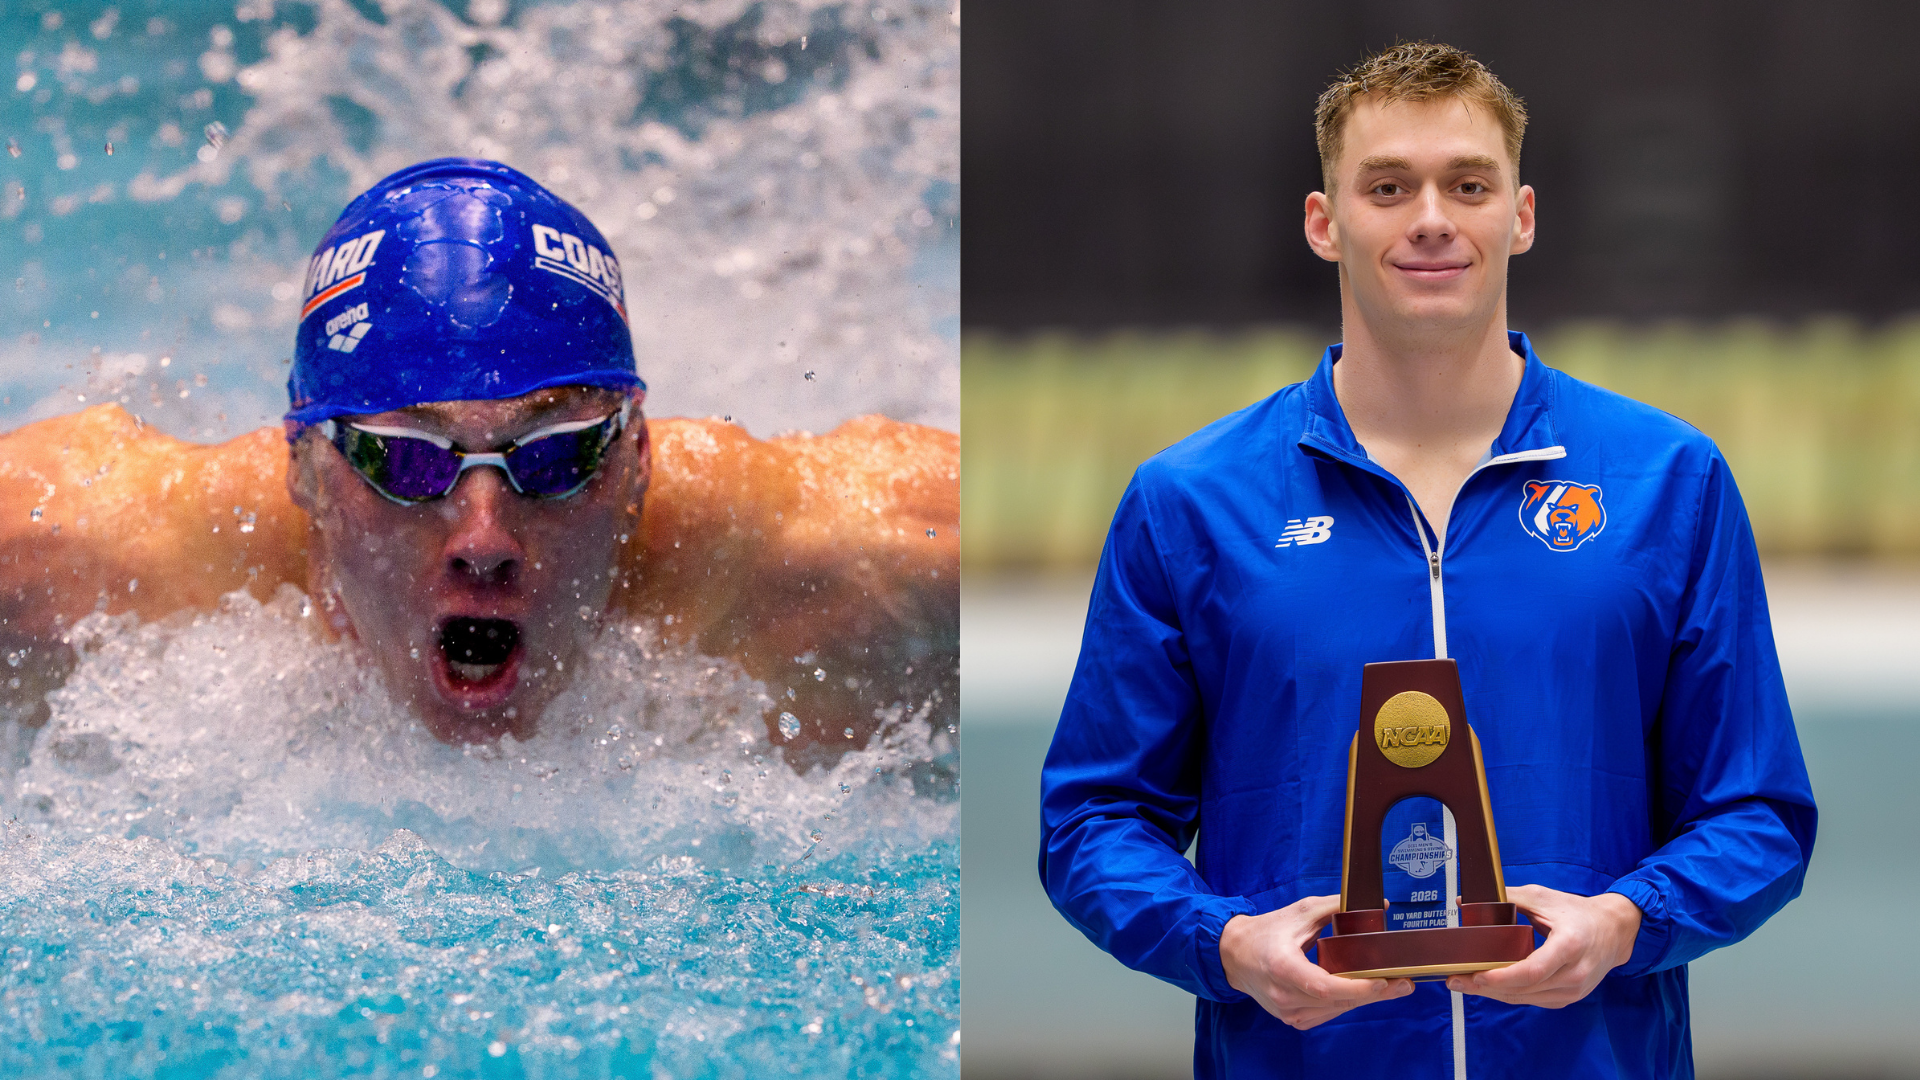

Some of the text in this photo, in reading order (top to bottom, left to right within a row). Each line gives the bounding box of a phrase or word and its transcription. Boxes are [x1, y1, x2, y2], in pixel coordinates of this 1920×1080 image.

[325, 302, 369, 336] arena
[1275, 515, 1335, 548] NB
[1381, 725, 1447, 748] NCAA
[1390, 850, 1452, 862] CHAMPIONSHIPS
[1411, 890, 1438, 902] 2026
[1406, 911, 1422, 920] YARD
[1423, 909, 1458, 919] BUTTERFLY
[1403, 919, 1428, 929] FOURTH
